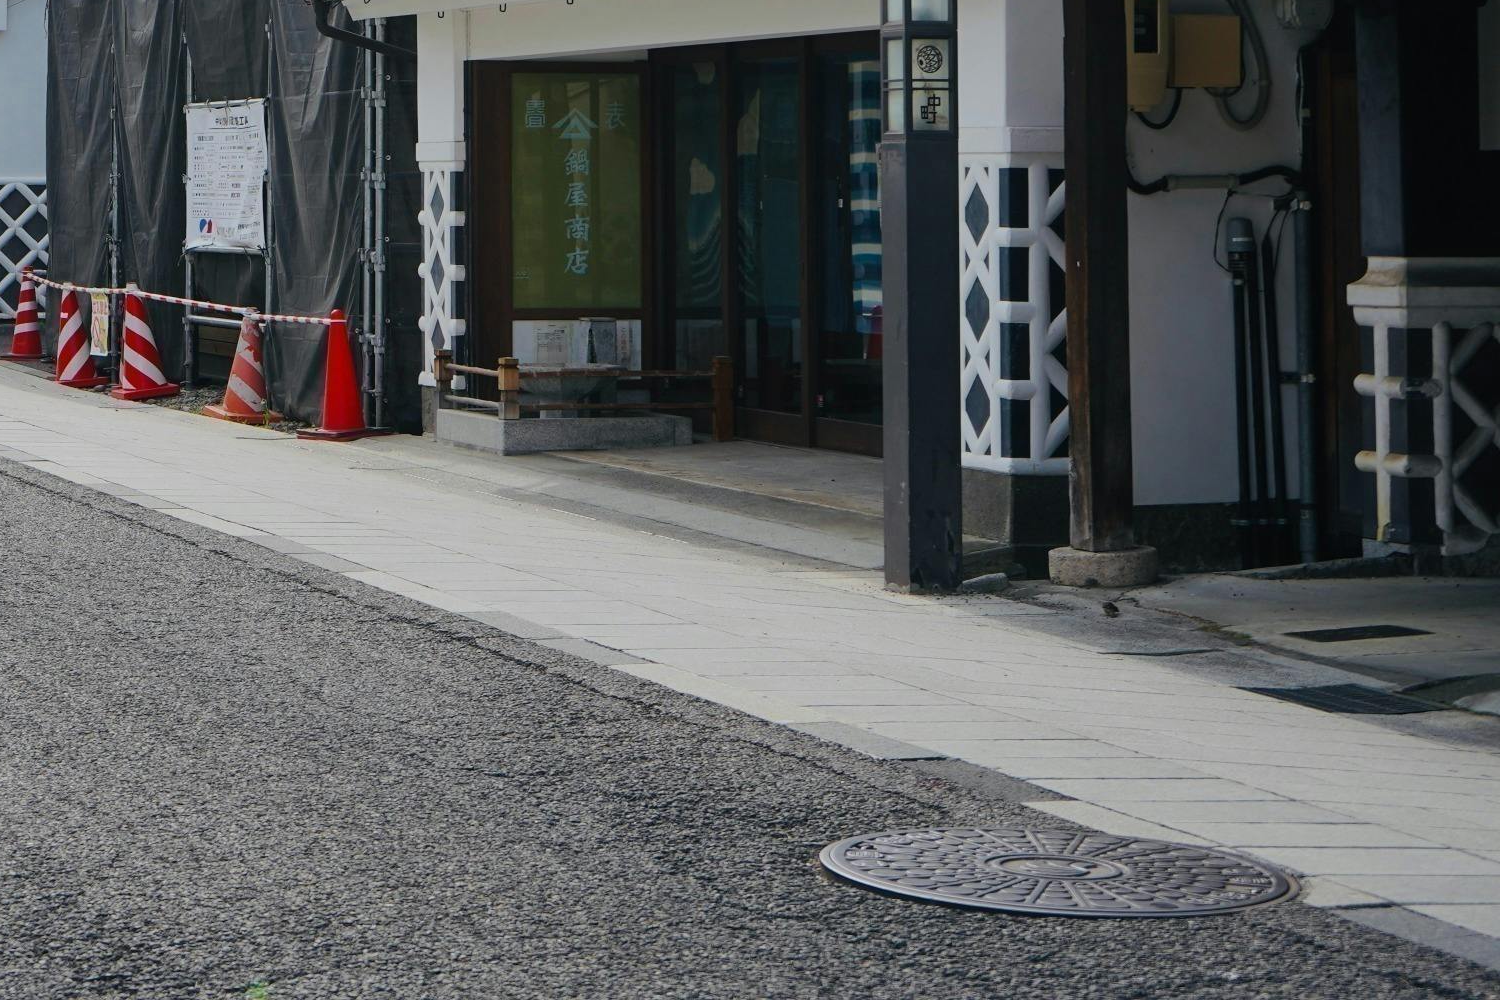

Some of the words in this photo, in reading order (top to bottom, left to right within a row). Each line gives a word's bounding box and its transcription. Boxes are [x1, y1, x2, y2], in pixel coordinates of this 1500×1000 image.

[921, 94, 941, 124] 中町
[564, 148, 590, 276] 鍋屋商店
